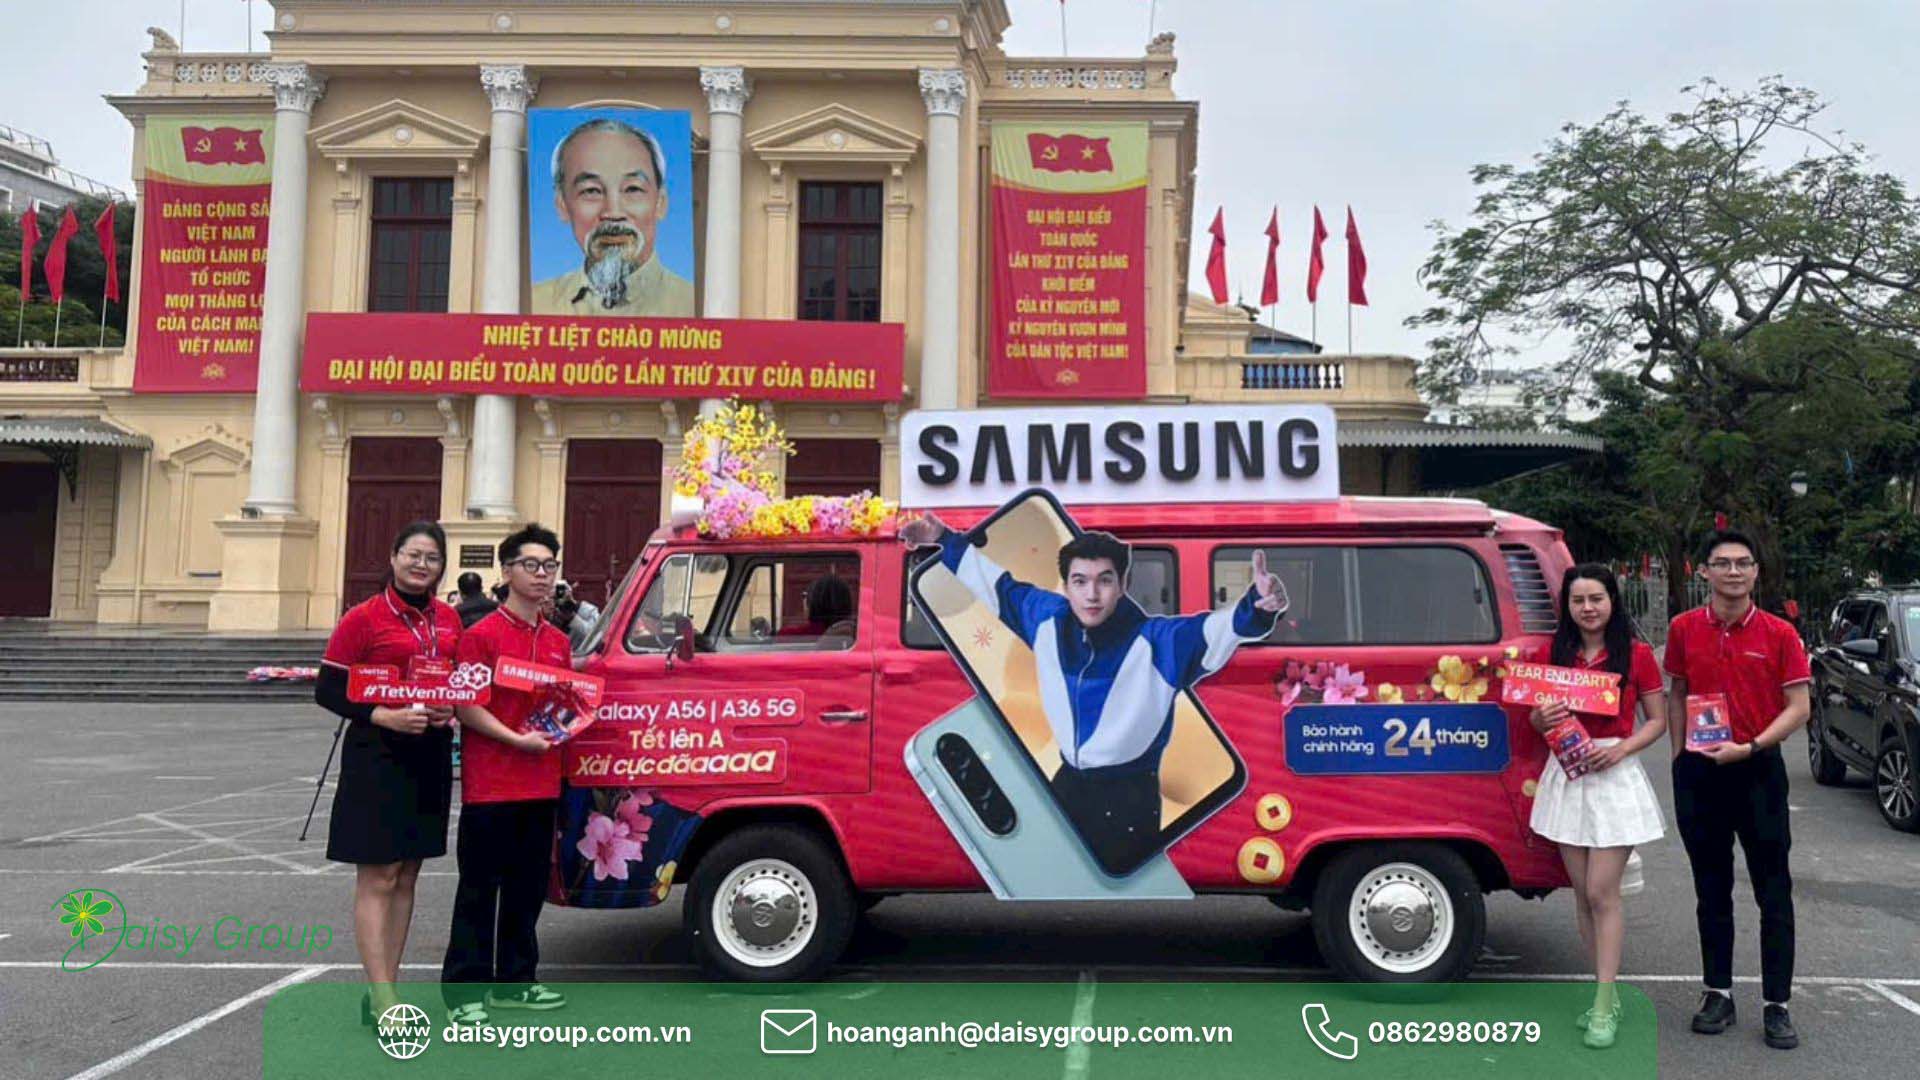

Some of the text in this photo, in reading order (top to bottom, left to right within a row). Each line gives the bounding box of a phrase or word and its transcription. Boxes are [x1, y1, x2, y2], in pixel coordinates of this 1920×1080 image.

[207, 200, 247, 220] CỘNG
[250, 197, 271, 217] SẢ
[187, 223, 256, 243] VIỆT NAM
[160, 246, 206, 263] NGƯỜI
[165, 293, 195, 312] MỌI
[157, 311, 187, 331] CỦA
[191, 313, 231, 331] CÁCH
[178, 336, 253, 357] VIỆT NAM!
[483, 321, 722, 351] NHIỆT LIỆT CHÀO MỪNG
[328, 359, 363, 384] ĐẠI
[368, 356, 404, 385] HỘI
[408, 360, 444, 385] ĐẠI
[450, 354, 496, 382] BIỂU
[503, 358, 556, 383] TOÀN
[562, 356, 618, 386] QUỐC
[671, 362, 712, 386] THỨ
[717, 365, 756, 387] XIV
[762, 360, 804, 388] CỦA
[810, 362, 876, 390] ĐẢNG!
[917, 418, 1321, 486] SAMSUNG
[1509, 664, 1543, 681] YEAR
[1545, 668, 1572, 684] END
[1574, 673, 1617, 690] PARTY
[364, 684, 477, 701] #TetVenToan
[593, 702, 660, 725] alaxy
[666, 701, 706, 719] A56
[722, 699, 762, 718] A36
[767, 698, 797, 717] 5G
[628, 725, 725, 750] Tết lên A
[1383, 717, 1436, 757] 24
[1436, 727, 1489, 749] tháng
[576, 754, 612, 776] Xài
[613, 756, 656, 780] cực
